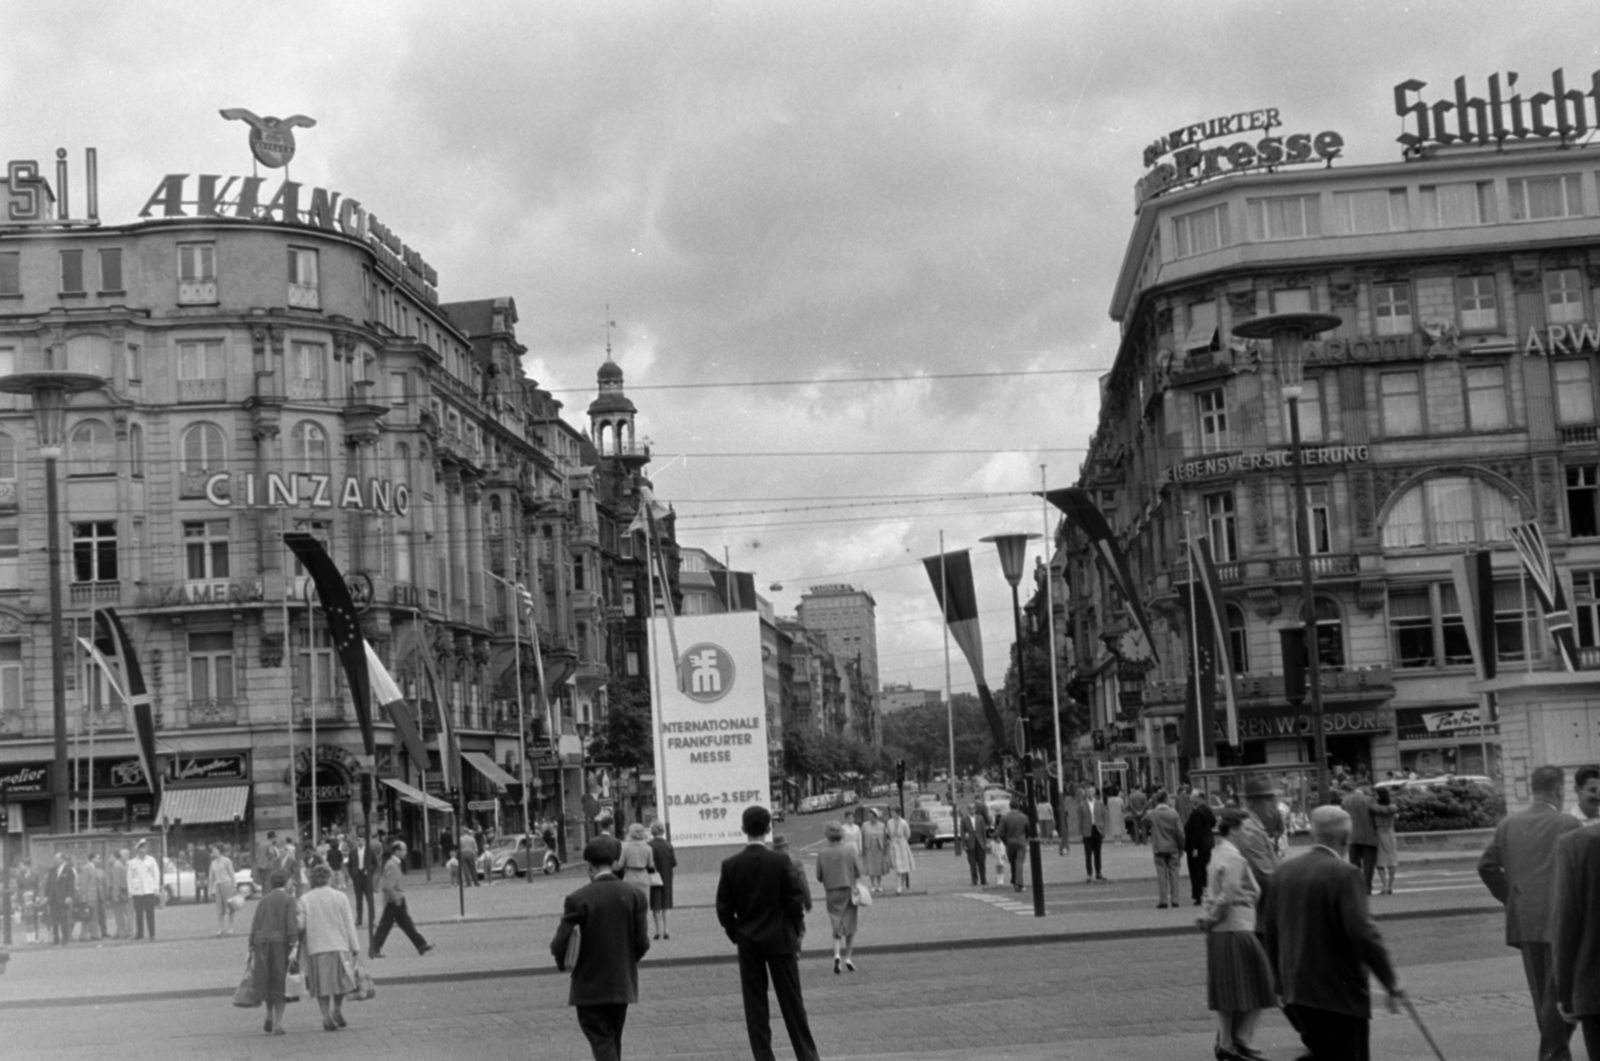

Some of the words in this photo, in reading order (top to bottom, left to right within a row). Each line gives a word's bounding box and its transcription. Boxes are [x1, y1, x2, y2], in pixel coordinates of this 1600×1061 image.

[1174, 131, 1345, 178] Presse
[1171, 445, 1370, 481] LEBENSVERSICERUNG
[205, 473, 410, 518] CINZANO
[661, 717, 760, 734] NTERNATIONALE
[667, 733, 752, 749] FRANKFURTER
[690, 750, 731, 764] MESSE
[698, 808, 727, 820] 1959
